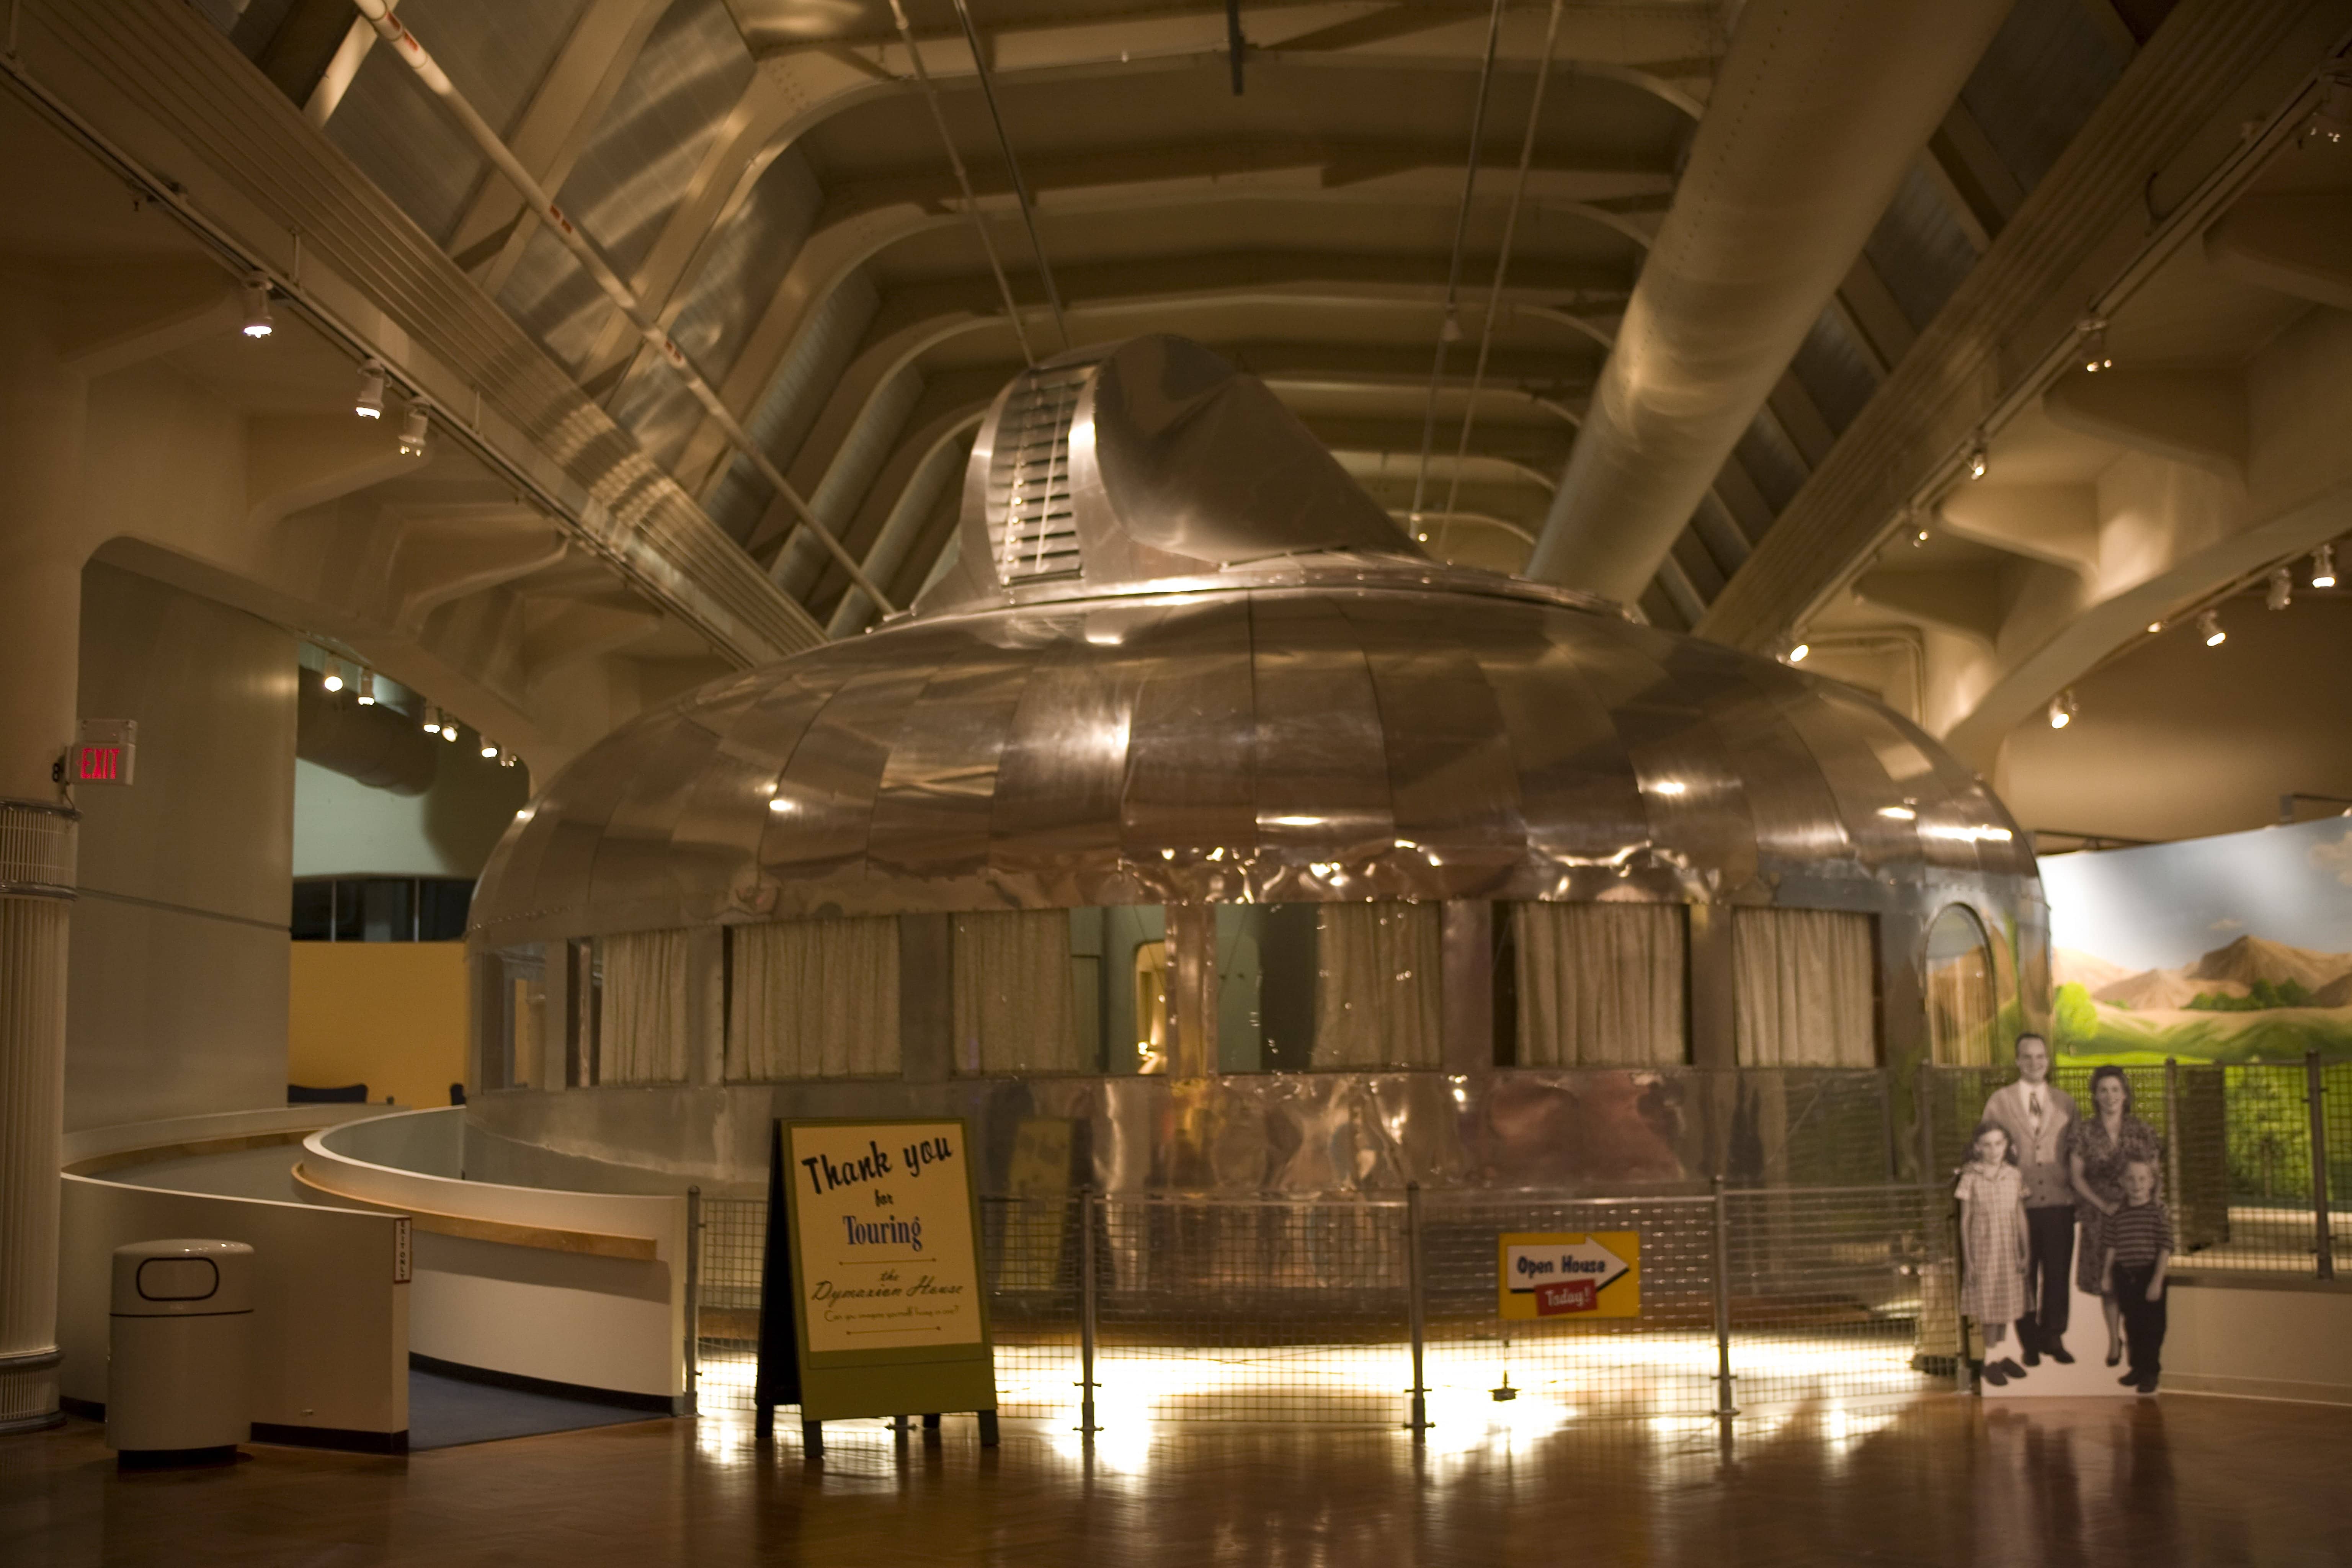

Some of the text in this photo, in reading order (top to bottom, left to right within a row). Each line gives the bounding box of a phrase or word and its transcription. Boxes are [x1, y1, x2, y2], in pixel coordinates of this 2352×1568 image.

[80, 748, 120, 779] EXIT
[801, 1137, 952, 1194] Thank you
[874, 1189, 893, 1207] for
[843, 1214, 922, 1251] Touring
[1517, 1254, 1606, 1278] Open House
[906, 1275, 963, 1297] House
[1545, 1287, 1591, 1307] Today!
